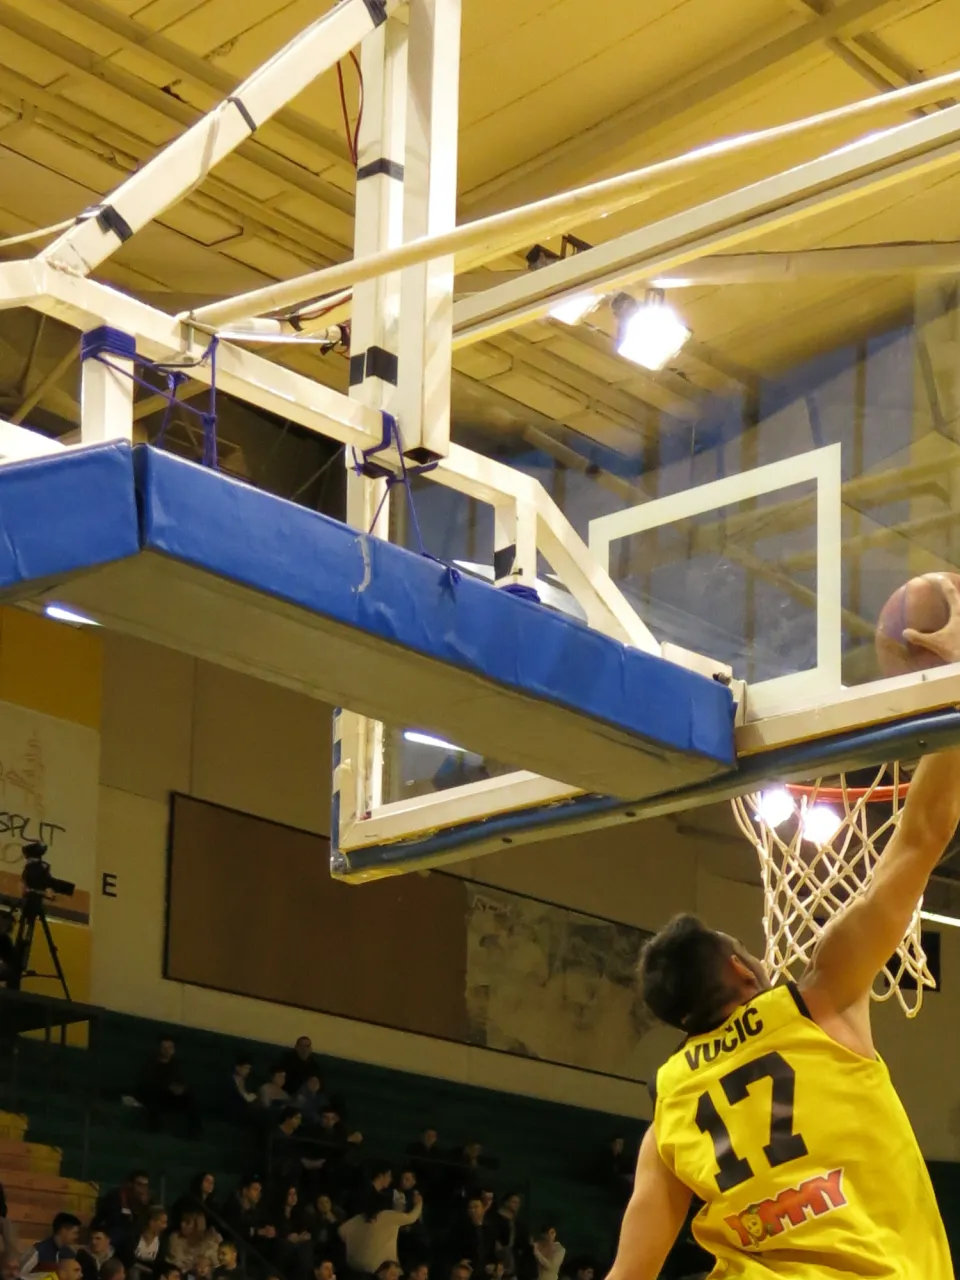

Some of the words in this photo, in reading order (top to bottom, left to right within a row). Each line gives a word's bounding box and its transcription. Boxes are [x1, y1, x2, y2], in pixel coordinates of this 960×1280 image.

[102, 872, 117, 897] E
[695, 1051, 809, 1193] 17
[722, 1168, 848, 1248] TOMMY
